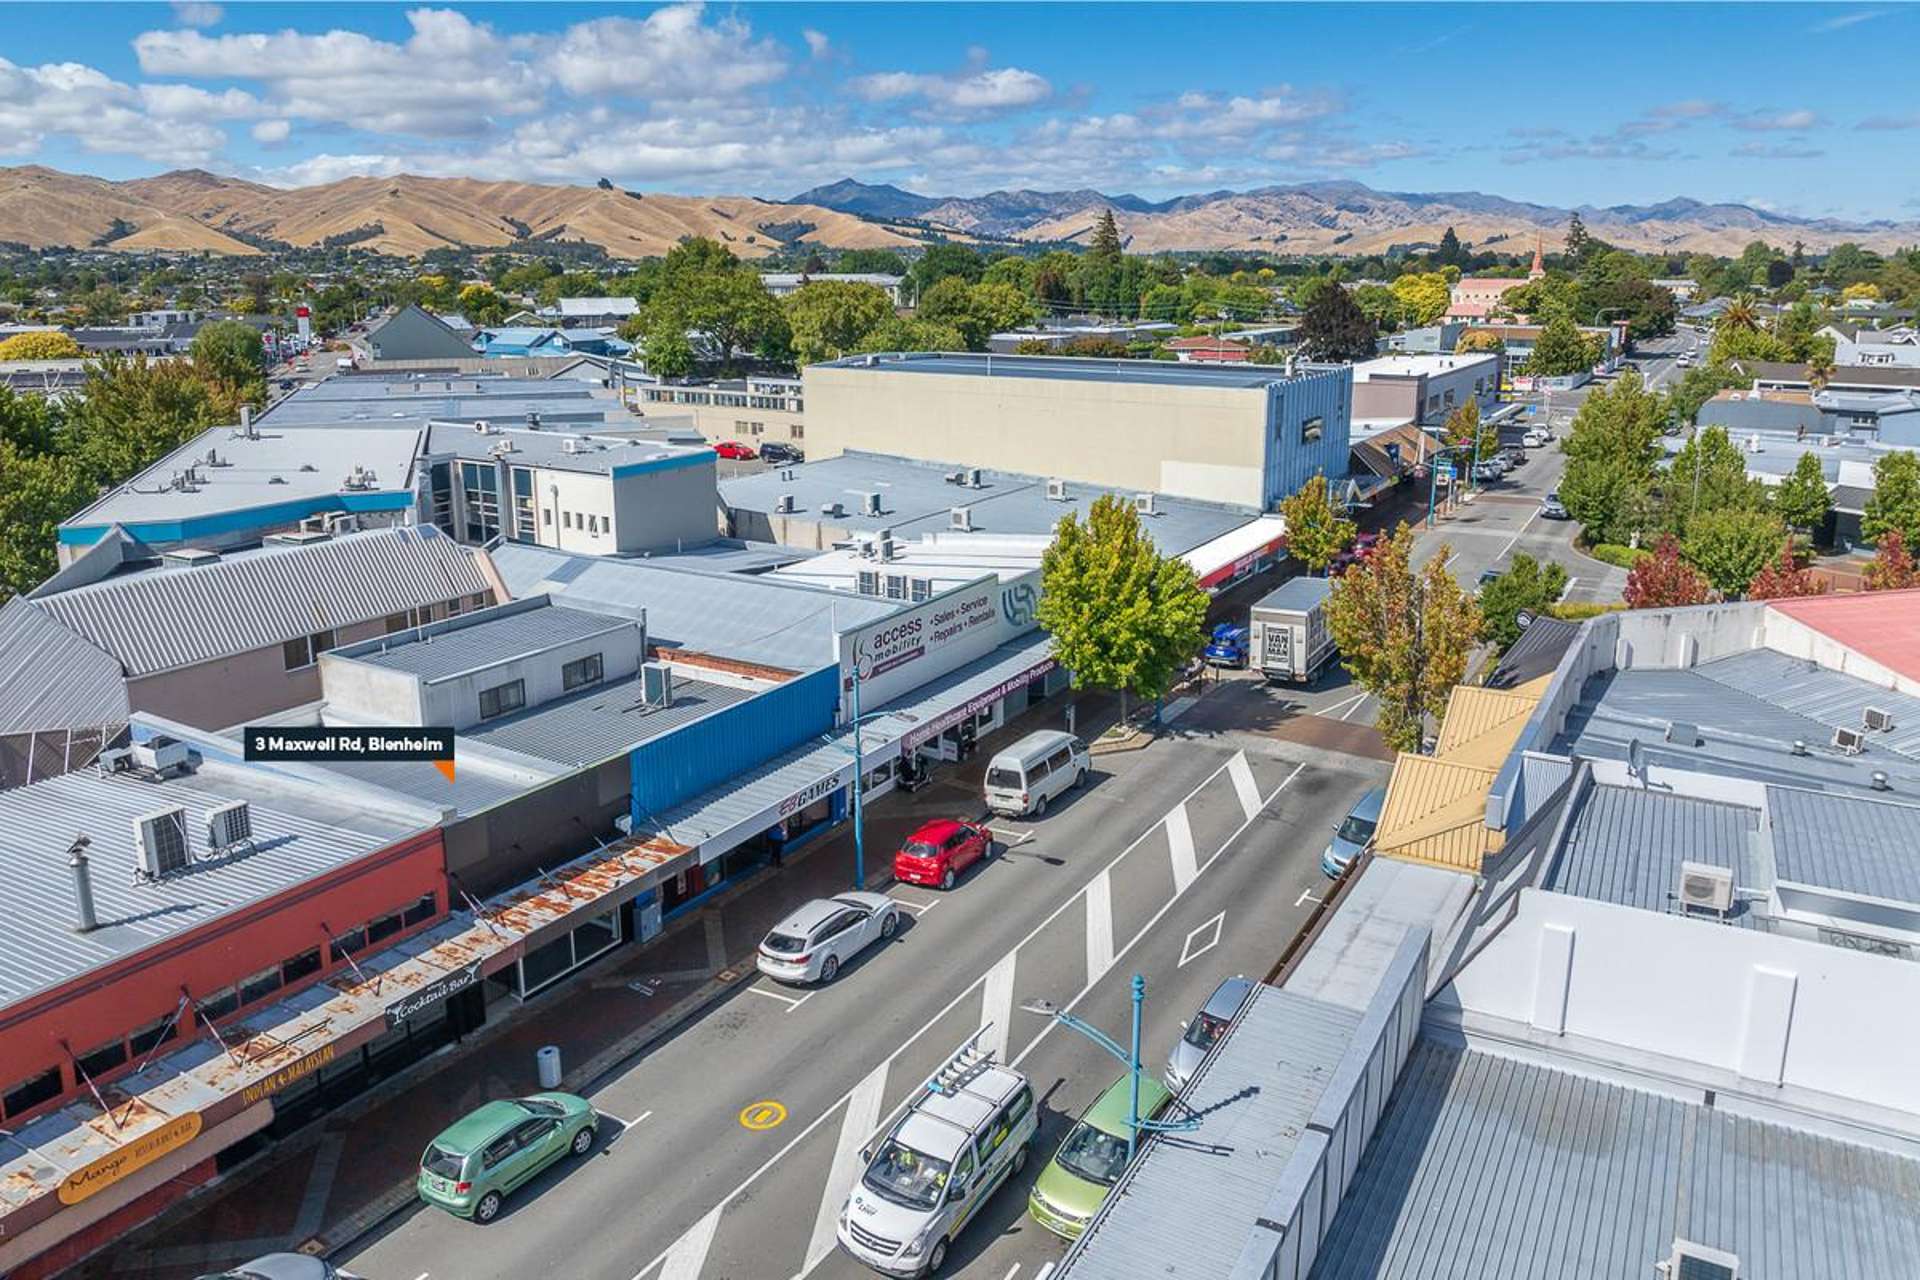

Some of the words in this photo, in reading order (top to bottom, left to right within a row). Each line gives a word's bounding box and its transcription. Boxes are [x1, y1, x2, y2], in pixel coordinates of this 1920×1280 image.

[934, 610, 955, 626] Sales
[960, 595, 989, 615] Service
[873, 618, 922, 649] access
[934, 622, 963, 643] Repairs
[1268, 634, 1289, 643] VAN
[874, 636, 922, 662] mobility
[967, 687, 1001, 713] Equipment
[1001, 684, 1007, 695] &
[1007, 672, 1029, 691] Mobility
[1030, 660, 1055, 679] Products
[399, 983, 449, 1018] Cocktail
[450, 974, 472, 992] Bar
[69, 1155, 128, 1191] Mango
